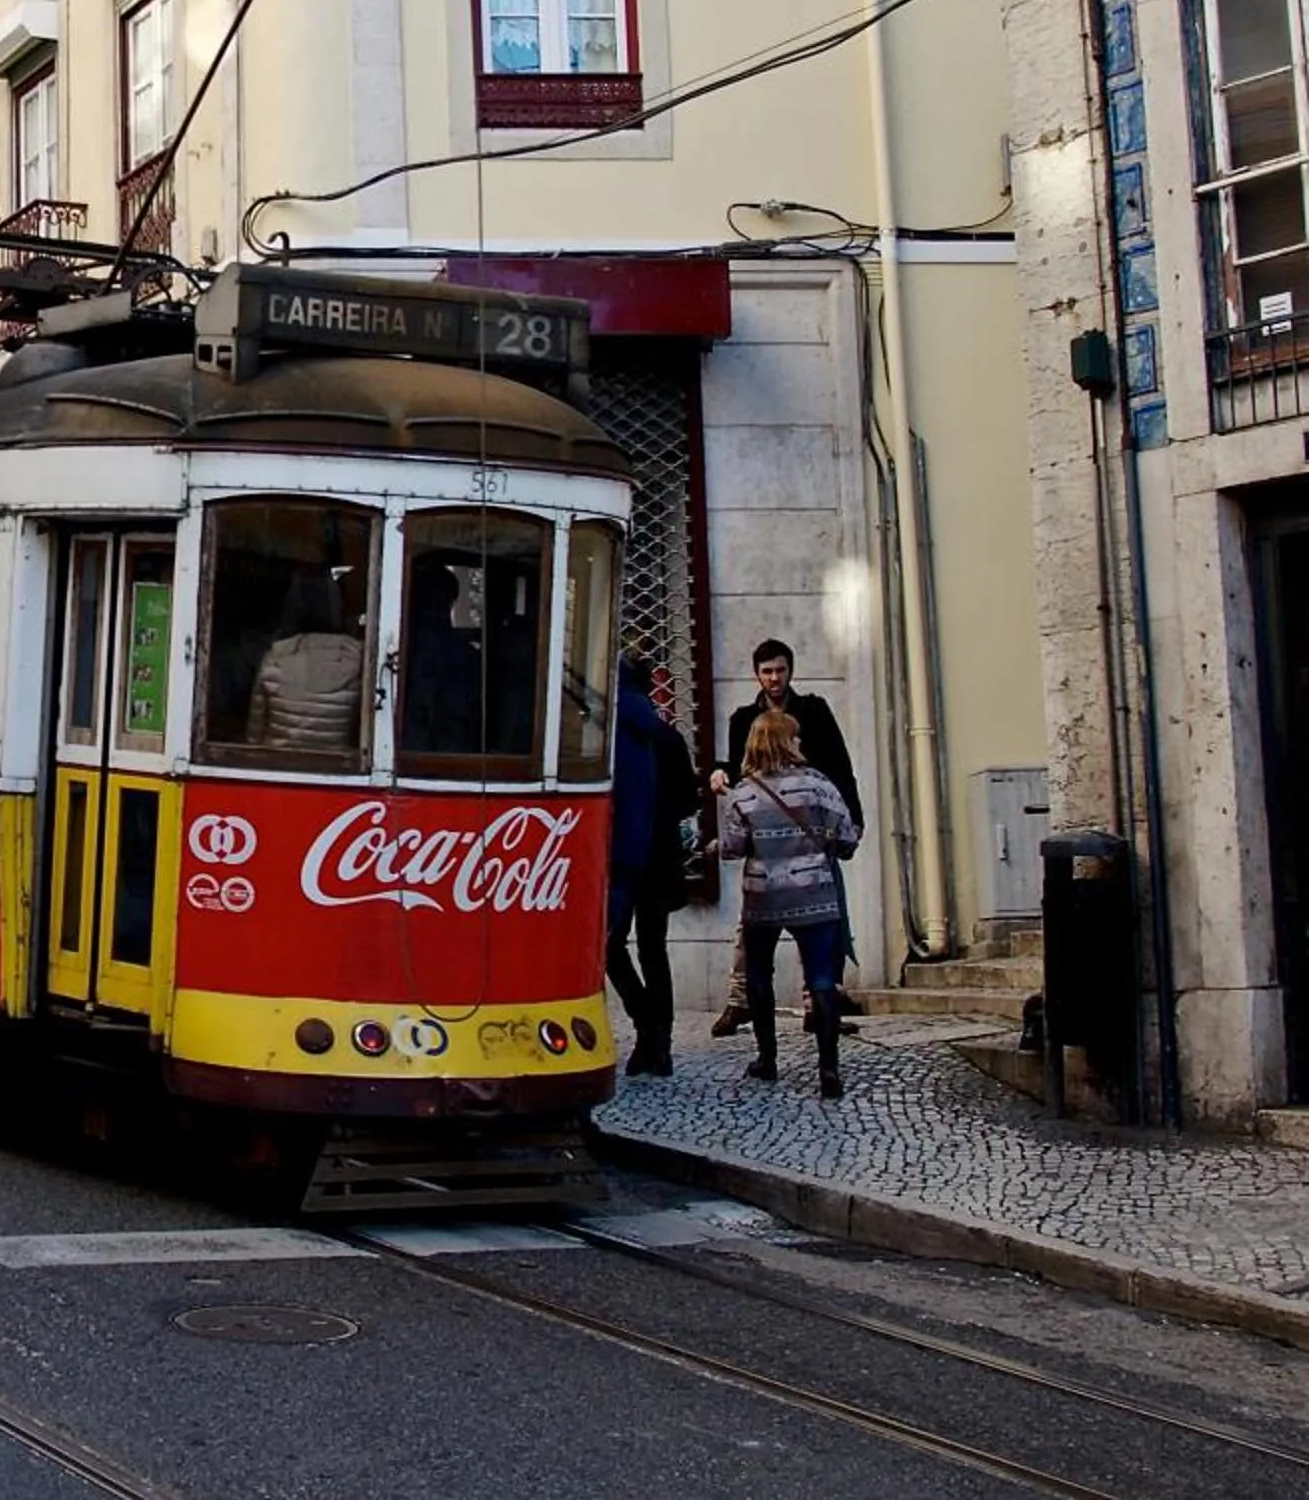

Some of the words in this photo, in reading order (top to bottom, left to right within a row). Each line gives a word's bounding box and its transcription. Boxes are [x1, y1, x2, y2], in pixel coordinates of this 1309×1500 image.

[269, 294, 407, 336] CARREIRA
[495, 311, 552, 359] 28
[300, 800, 582, 913] Coca-Cola
